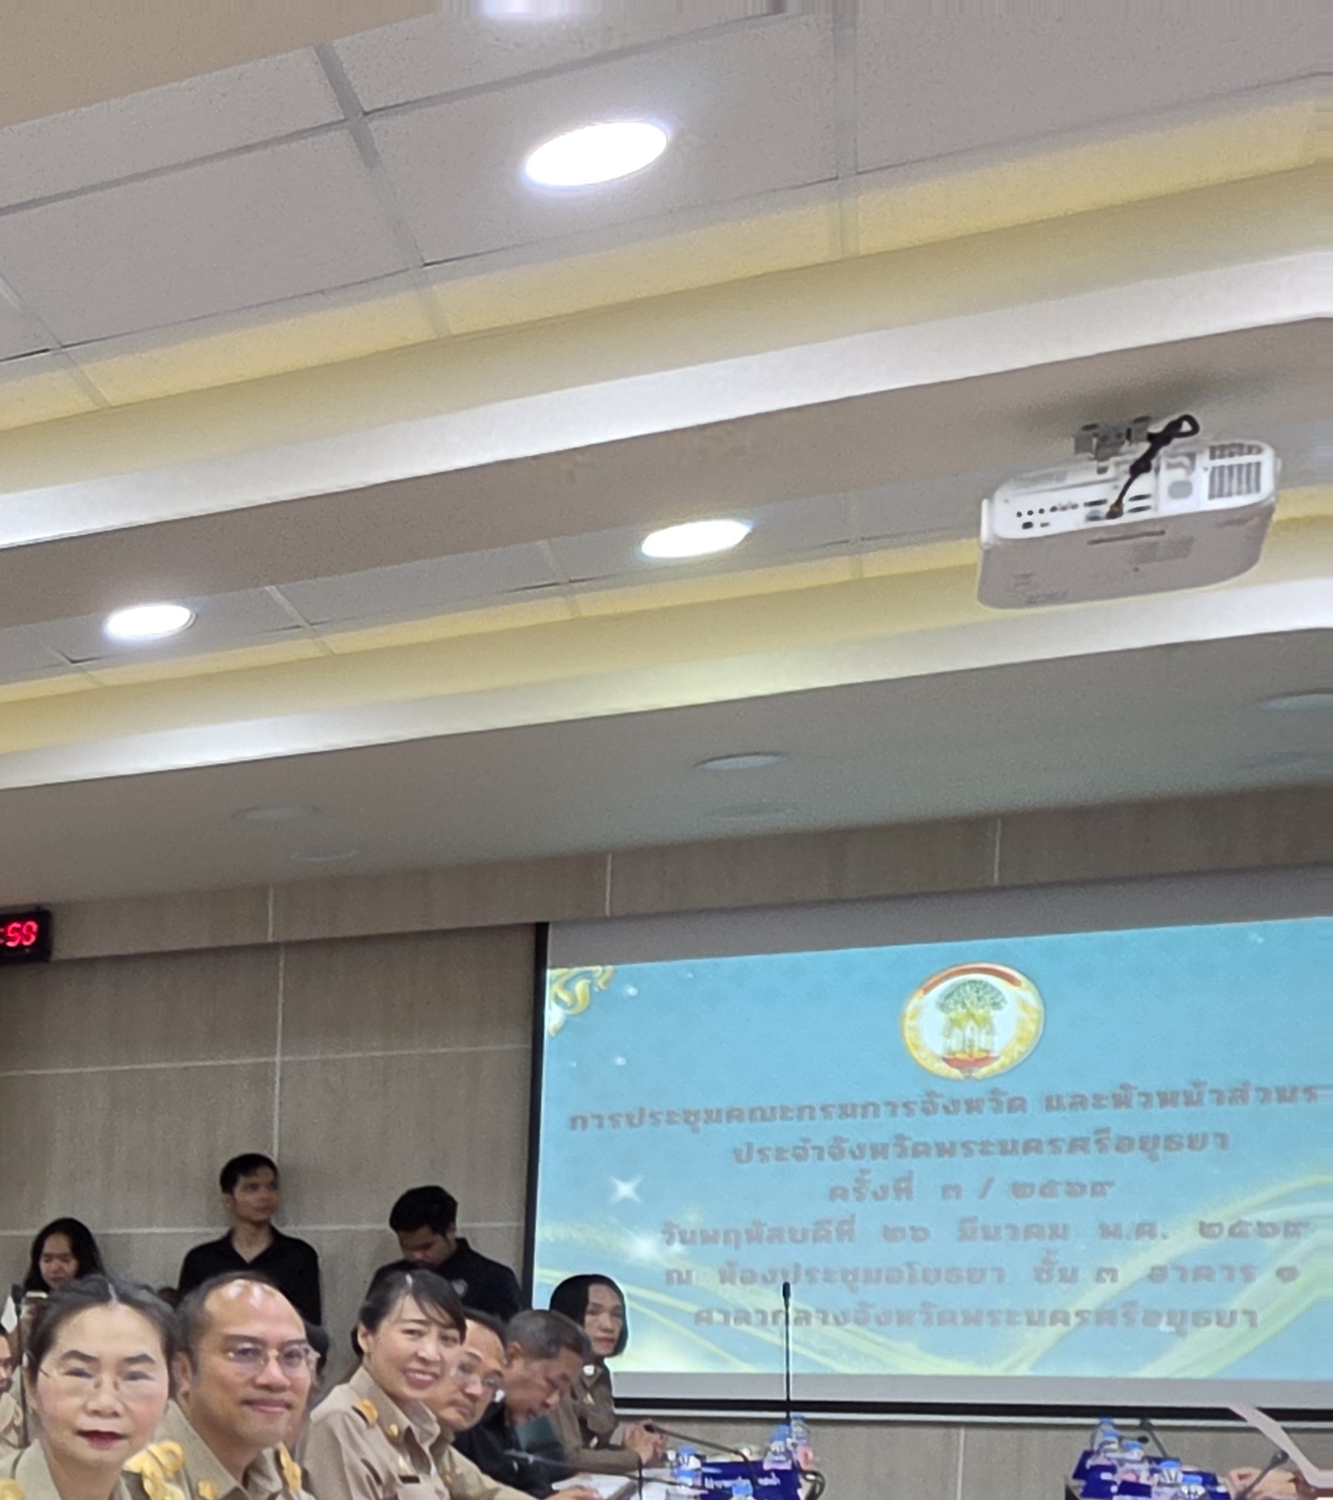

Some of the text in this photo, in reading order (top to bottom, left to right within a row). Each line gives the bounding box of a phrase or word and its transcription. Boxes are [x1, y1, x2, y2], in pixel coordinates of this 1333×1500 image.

[569, 1088, 1028, 1135] การประชุมคณะกรมการจังหวัด
[732, 1125, 1230, 1165] ประจำจังหวัดพระนครศรีอยุธยา
[829, 1168, 915, 1203] ครั้งที่
[941, 1182, 963, 1200] ๓
[978, 1177, 995, 1200] /
[661, 1212, 857, 1250] วันพฤหัสบดีที่
[957, 1214, 1071, 1243] มีนาคม
[1099, 1219, 1169, 1241] พ.ศ.
[666, 1264, 693, 1287] ณ
[718, 1258, 1006, 1295] ห้องประชุมอโยธยา
[1034, 1248, 1080, 1285] ชั้น
[1147, 1263, 1258, 1286] อาคาร
[1274, 1262, 1301, 1285] ๑
[693, 1299, 1259, 1337] ศาลากลางจังหวัดพระนครศรีอยุธยา
